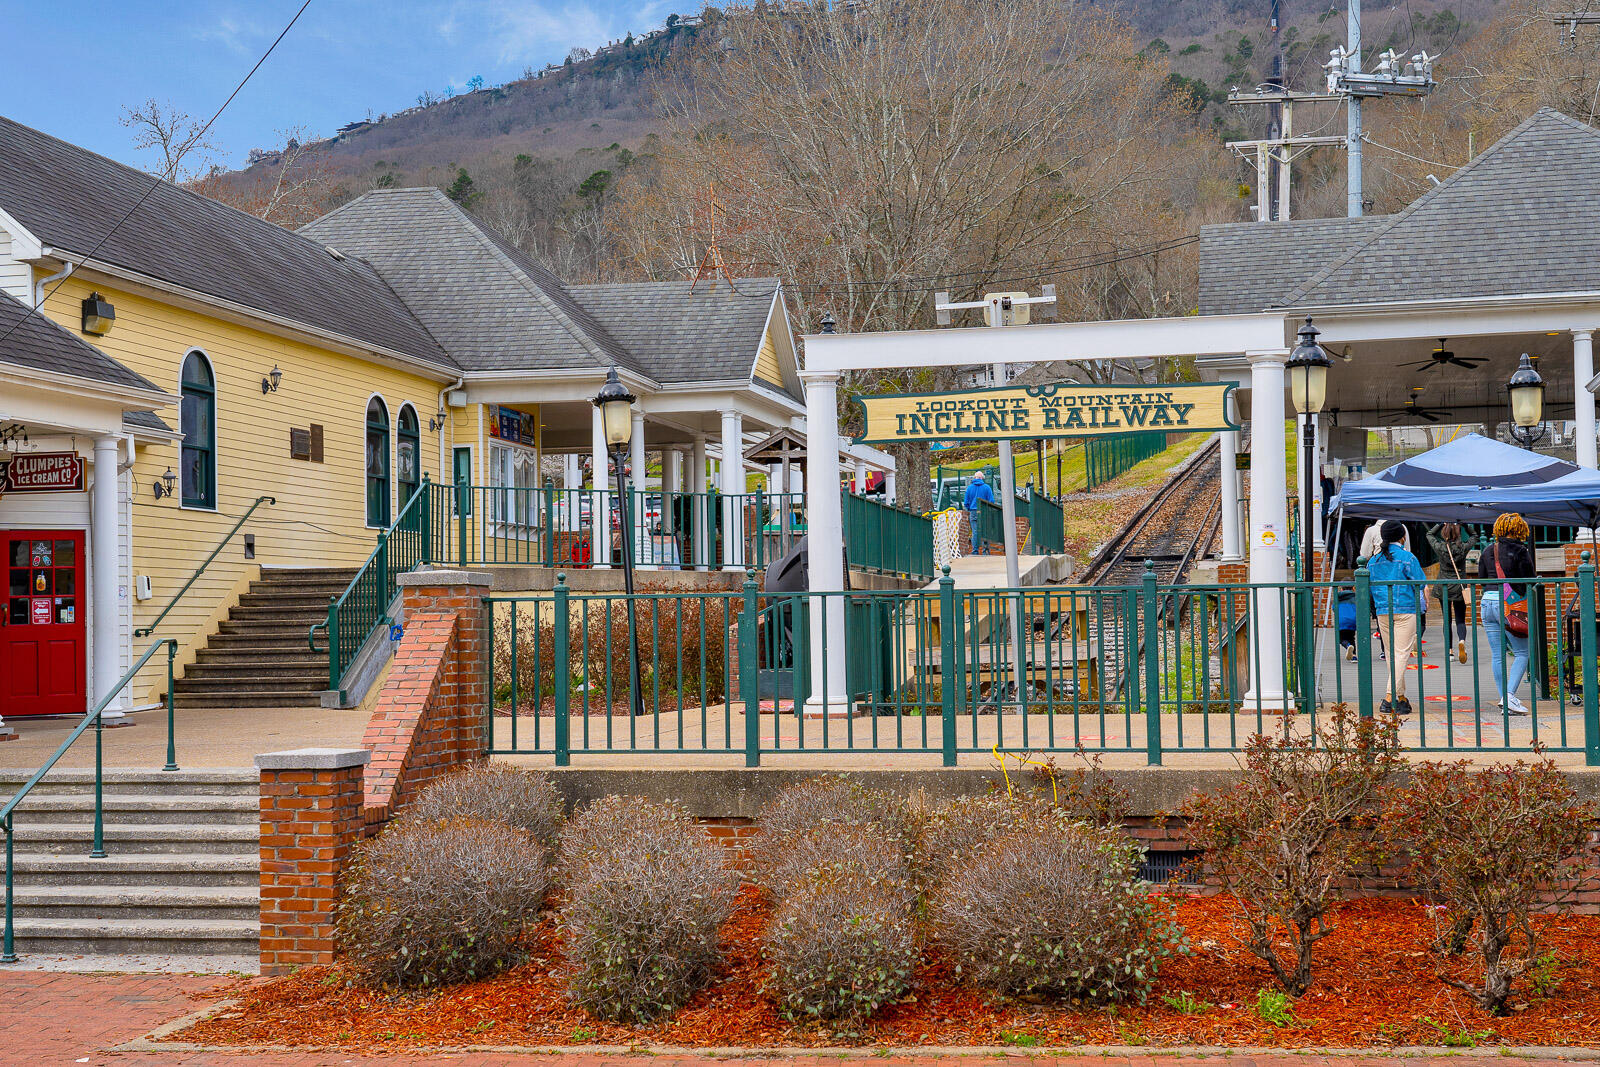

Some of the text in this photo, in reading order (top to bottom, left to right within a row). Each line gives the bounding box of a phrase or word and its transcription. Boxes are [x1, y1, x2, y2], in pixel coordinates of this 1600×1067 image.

[916, 392, 1173, 412] LOOKOUT MOUNTAIN
[895, 403, 1194, 435] INCLINE RAILWAY
[16, 457, 71, 474] CLUMPIES
[17, 475, 31, 484] ICE
[31, 471, 60, 484] CREAM
